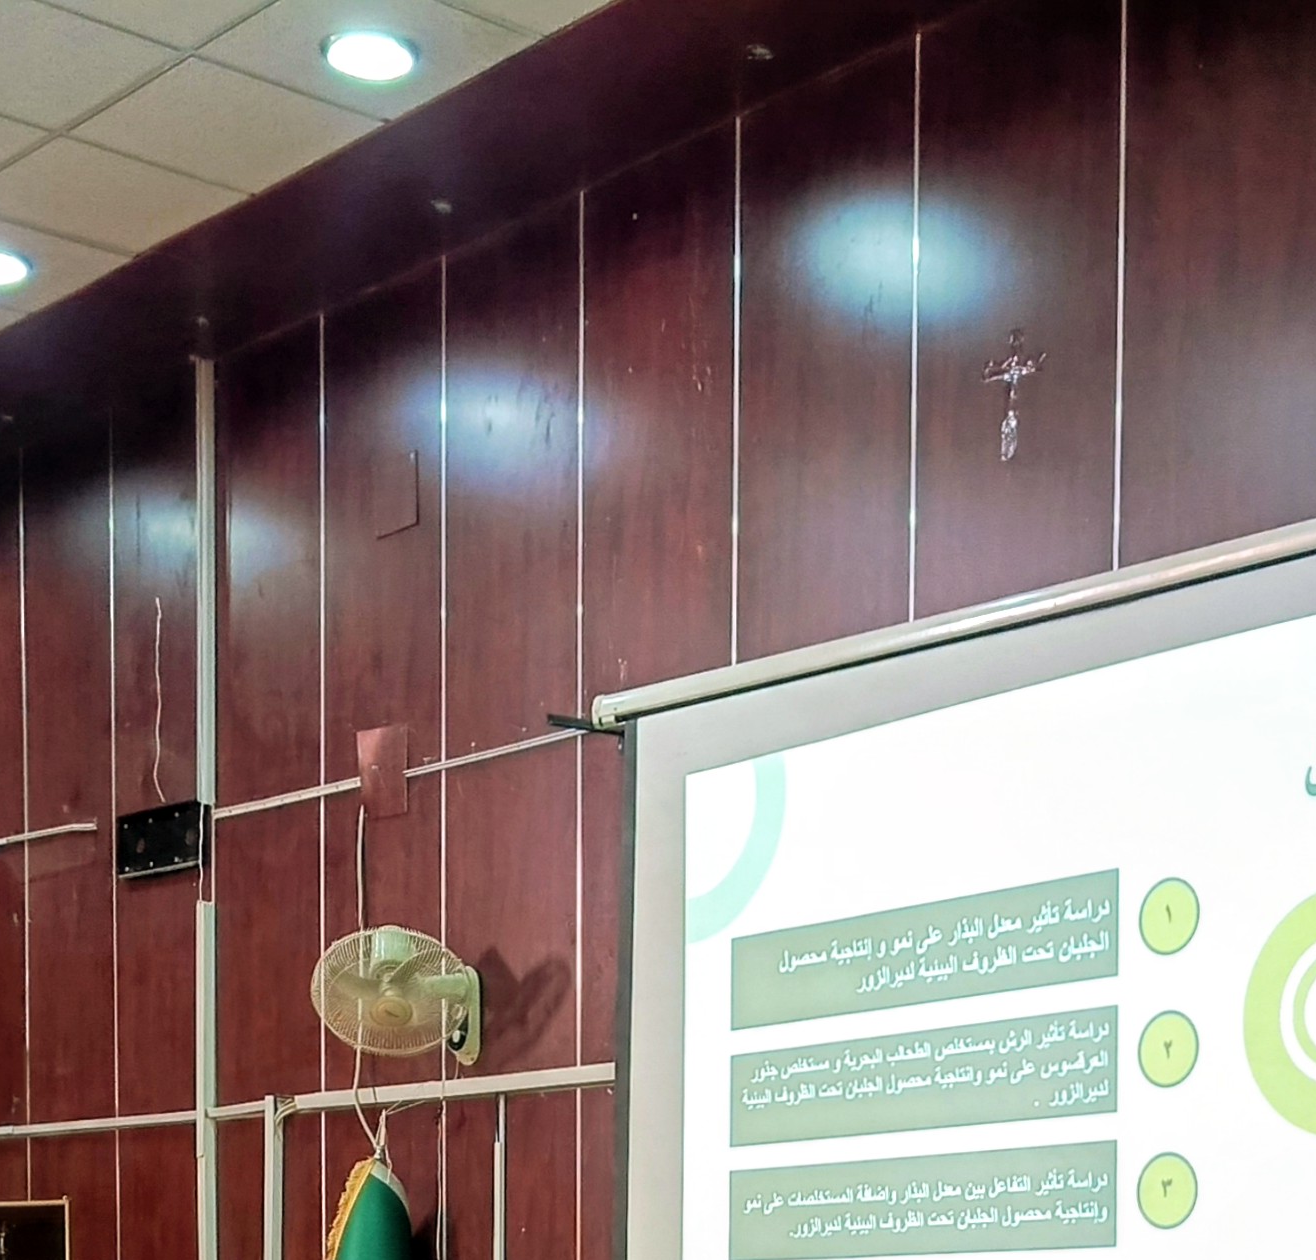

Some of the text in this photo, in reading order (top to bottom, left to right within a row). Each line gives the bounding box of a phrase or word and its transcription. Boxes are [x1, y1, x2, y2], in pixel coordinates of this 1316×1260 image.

[1164, 904, 1173, 923] ١
[778, 898, 1111, 974] دراسة تأثير معدل البذار على نمو و إنتاجية محصول
[1057, 930, 1110, 963] الجلبان
[961, 945, 1017, 975] الظروف
[1021, 940, 1055, 964] تحت
[917, 955, 958, 982] البيئية
[750, 1019, 1110, 1084] دراسة تأثير الرش بمستخلص الطحالب البحرية و مستخلص جذور
[1162, 1038, 1174, 1059] ٢
[985, 1061, 1008, 1085] نمو
[1010, 1058, 1035, 1085] على
[774, 1082, 816, 1106] الظروف
[817, 1080, 843, 1097] تحت
[845, 1075, 883, 1100] الجلبان
[886, 1074, 932, 1095] محصول
[741, 1088, 772, 1110] البيئية
[899, 1180, 930, 1204] البذار
[932, 1180, 962, 1202] معدل
[964, 1182, 986, 1201] بين
[988, 1174, 1031, 1199] التفاعل
[1034, 1168, 1064, 1197] تأثير
[1067, 1168, 1108, 1193] دراسة
[1160, 1177, 1174, 1198] ٣
[743, 1193, 762, 1214] نمو
[763, 1192, 784, 1215] على
[787, 1186, 854, 1208] المستخلصات
[844, 1212, 876, 1236] البيئية
[879, 1209, 924, 1233] الظروف
[927, 1210, 954, 1226] تحت
[956, 1206, 998, 1231] الجلبان
[1001, 1204, 1052, 1228] محصول
[1055, 1200, 1108, 1225] وإنتاجية
